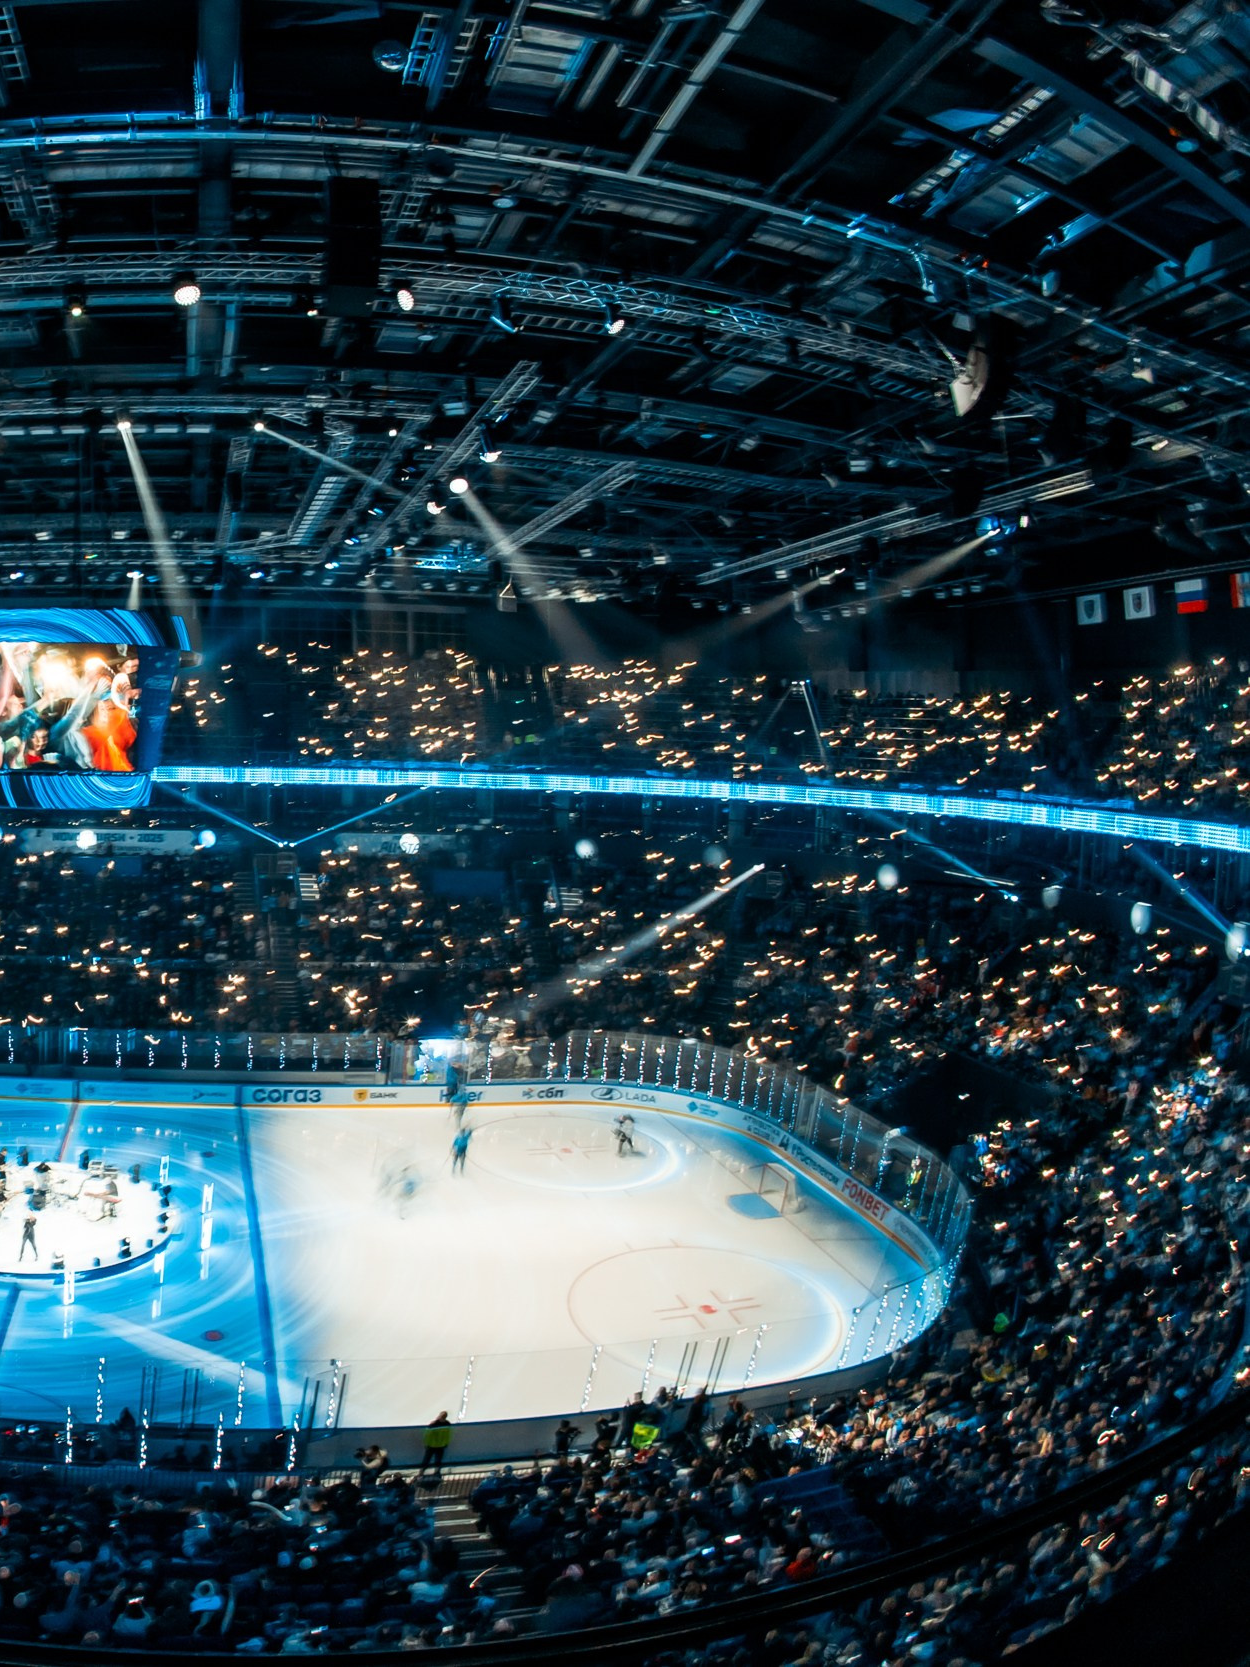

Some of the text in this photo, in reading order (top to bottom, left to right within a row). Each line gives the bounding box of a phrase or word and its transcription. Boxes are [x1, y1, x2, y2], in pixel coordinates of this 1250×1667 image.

[137, 833, 164, 842] 2025
[537, 1087, 565, 1099] сбп
[625, 1092, 657, 1103] LADA
[842, 1177, 890, 1222] FONBET
